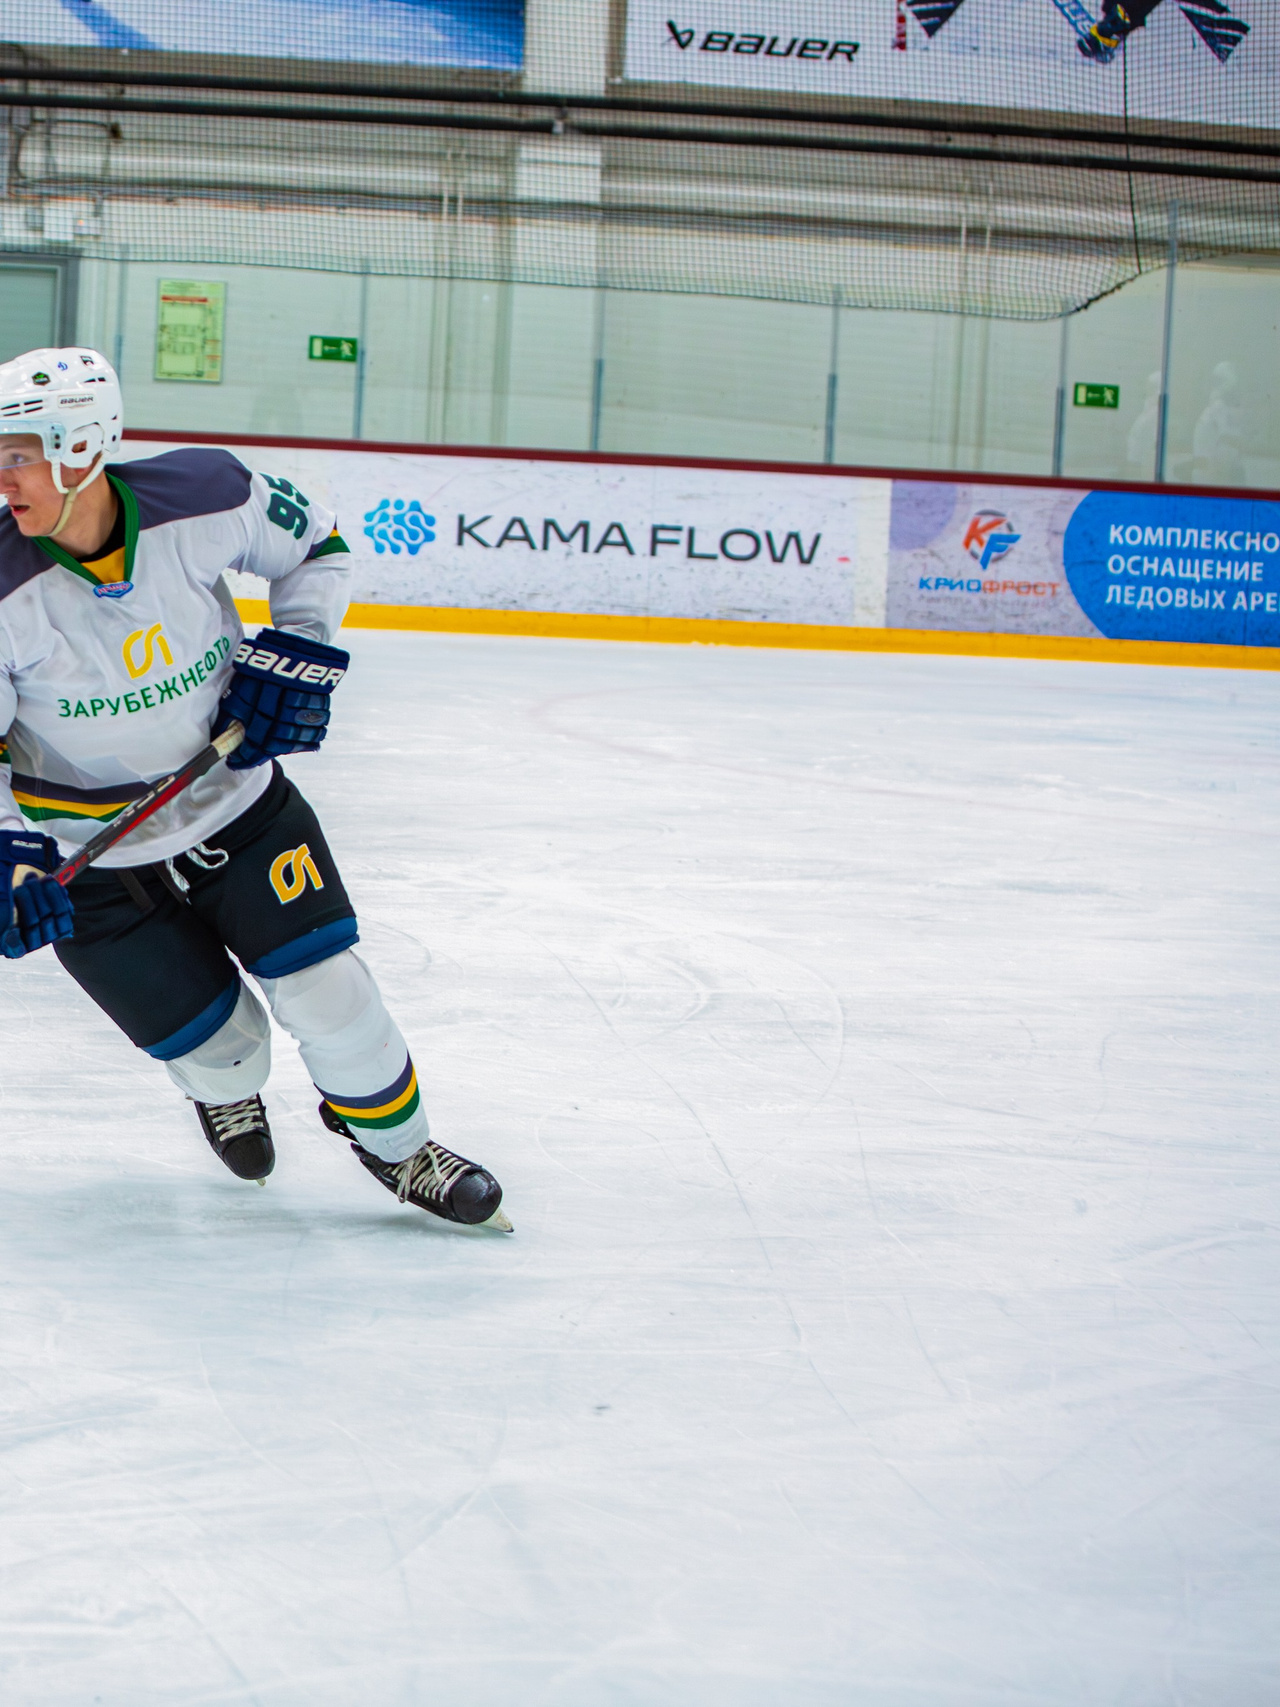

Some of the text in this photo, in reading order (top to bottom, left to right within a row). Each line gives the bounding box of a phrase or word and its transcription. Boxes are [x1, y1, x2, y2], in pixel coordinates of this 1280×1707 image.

[266, 472, 309, 540] 95
[457, 514, 822, 565] KAMA FLOW
[918, 577, 1061, 597] КРИОФРОСТ
[1107, 554, 1264, 583] ОСНАЩЕНИЕ
[1105, 584, 1280, 612] ЛЕДОВЫХ АРЕ
[57, 635, 231, 718] ЗАРУБЕЖНЕФТЬ
